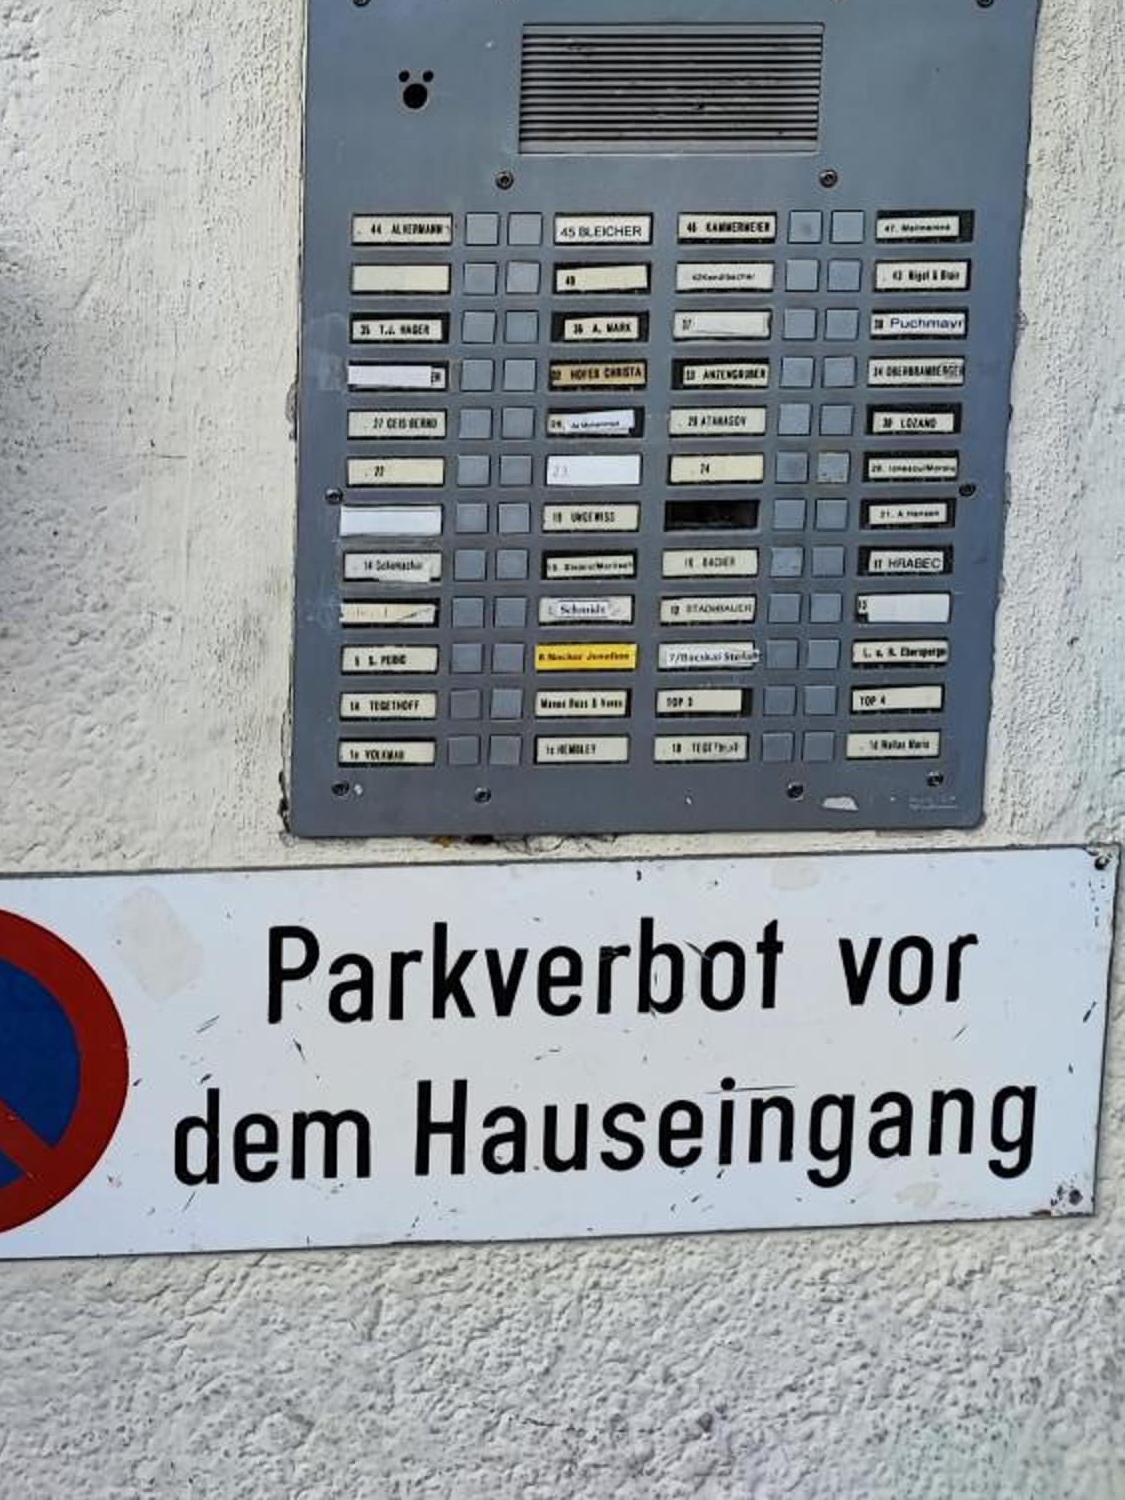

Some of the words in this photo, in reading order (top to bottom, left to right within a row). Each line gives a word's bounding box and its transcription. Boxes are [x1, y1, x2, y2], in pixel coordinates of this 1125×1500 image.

[561, 227, 575, 237] 45
[579, 226, 642, 237] BLEICHER
[607, 323, 631, 332] MARK
[888, 558, 941, 568] HRABEC
[370, 700, 420, 711] TEGETHOFF
[667, 697, 683, 707] TOP
[860, 696, 876, 706] TOP
[268, 917, 783, 1024] Parkverbot
[839, 932, 978, 1005] vor
[174, 1088, 371, 1185] dem
[414, 1076, 1038, 1187] Hauseingang
